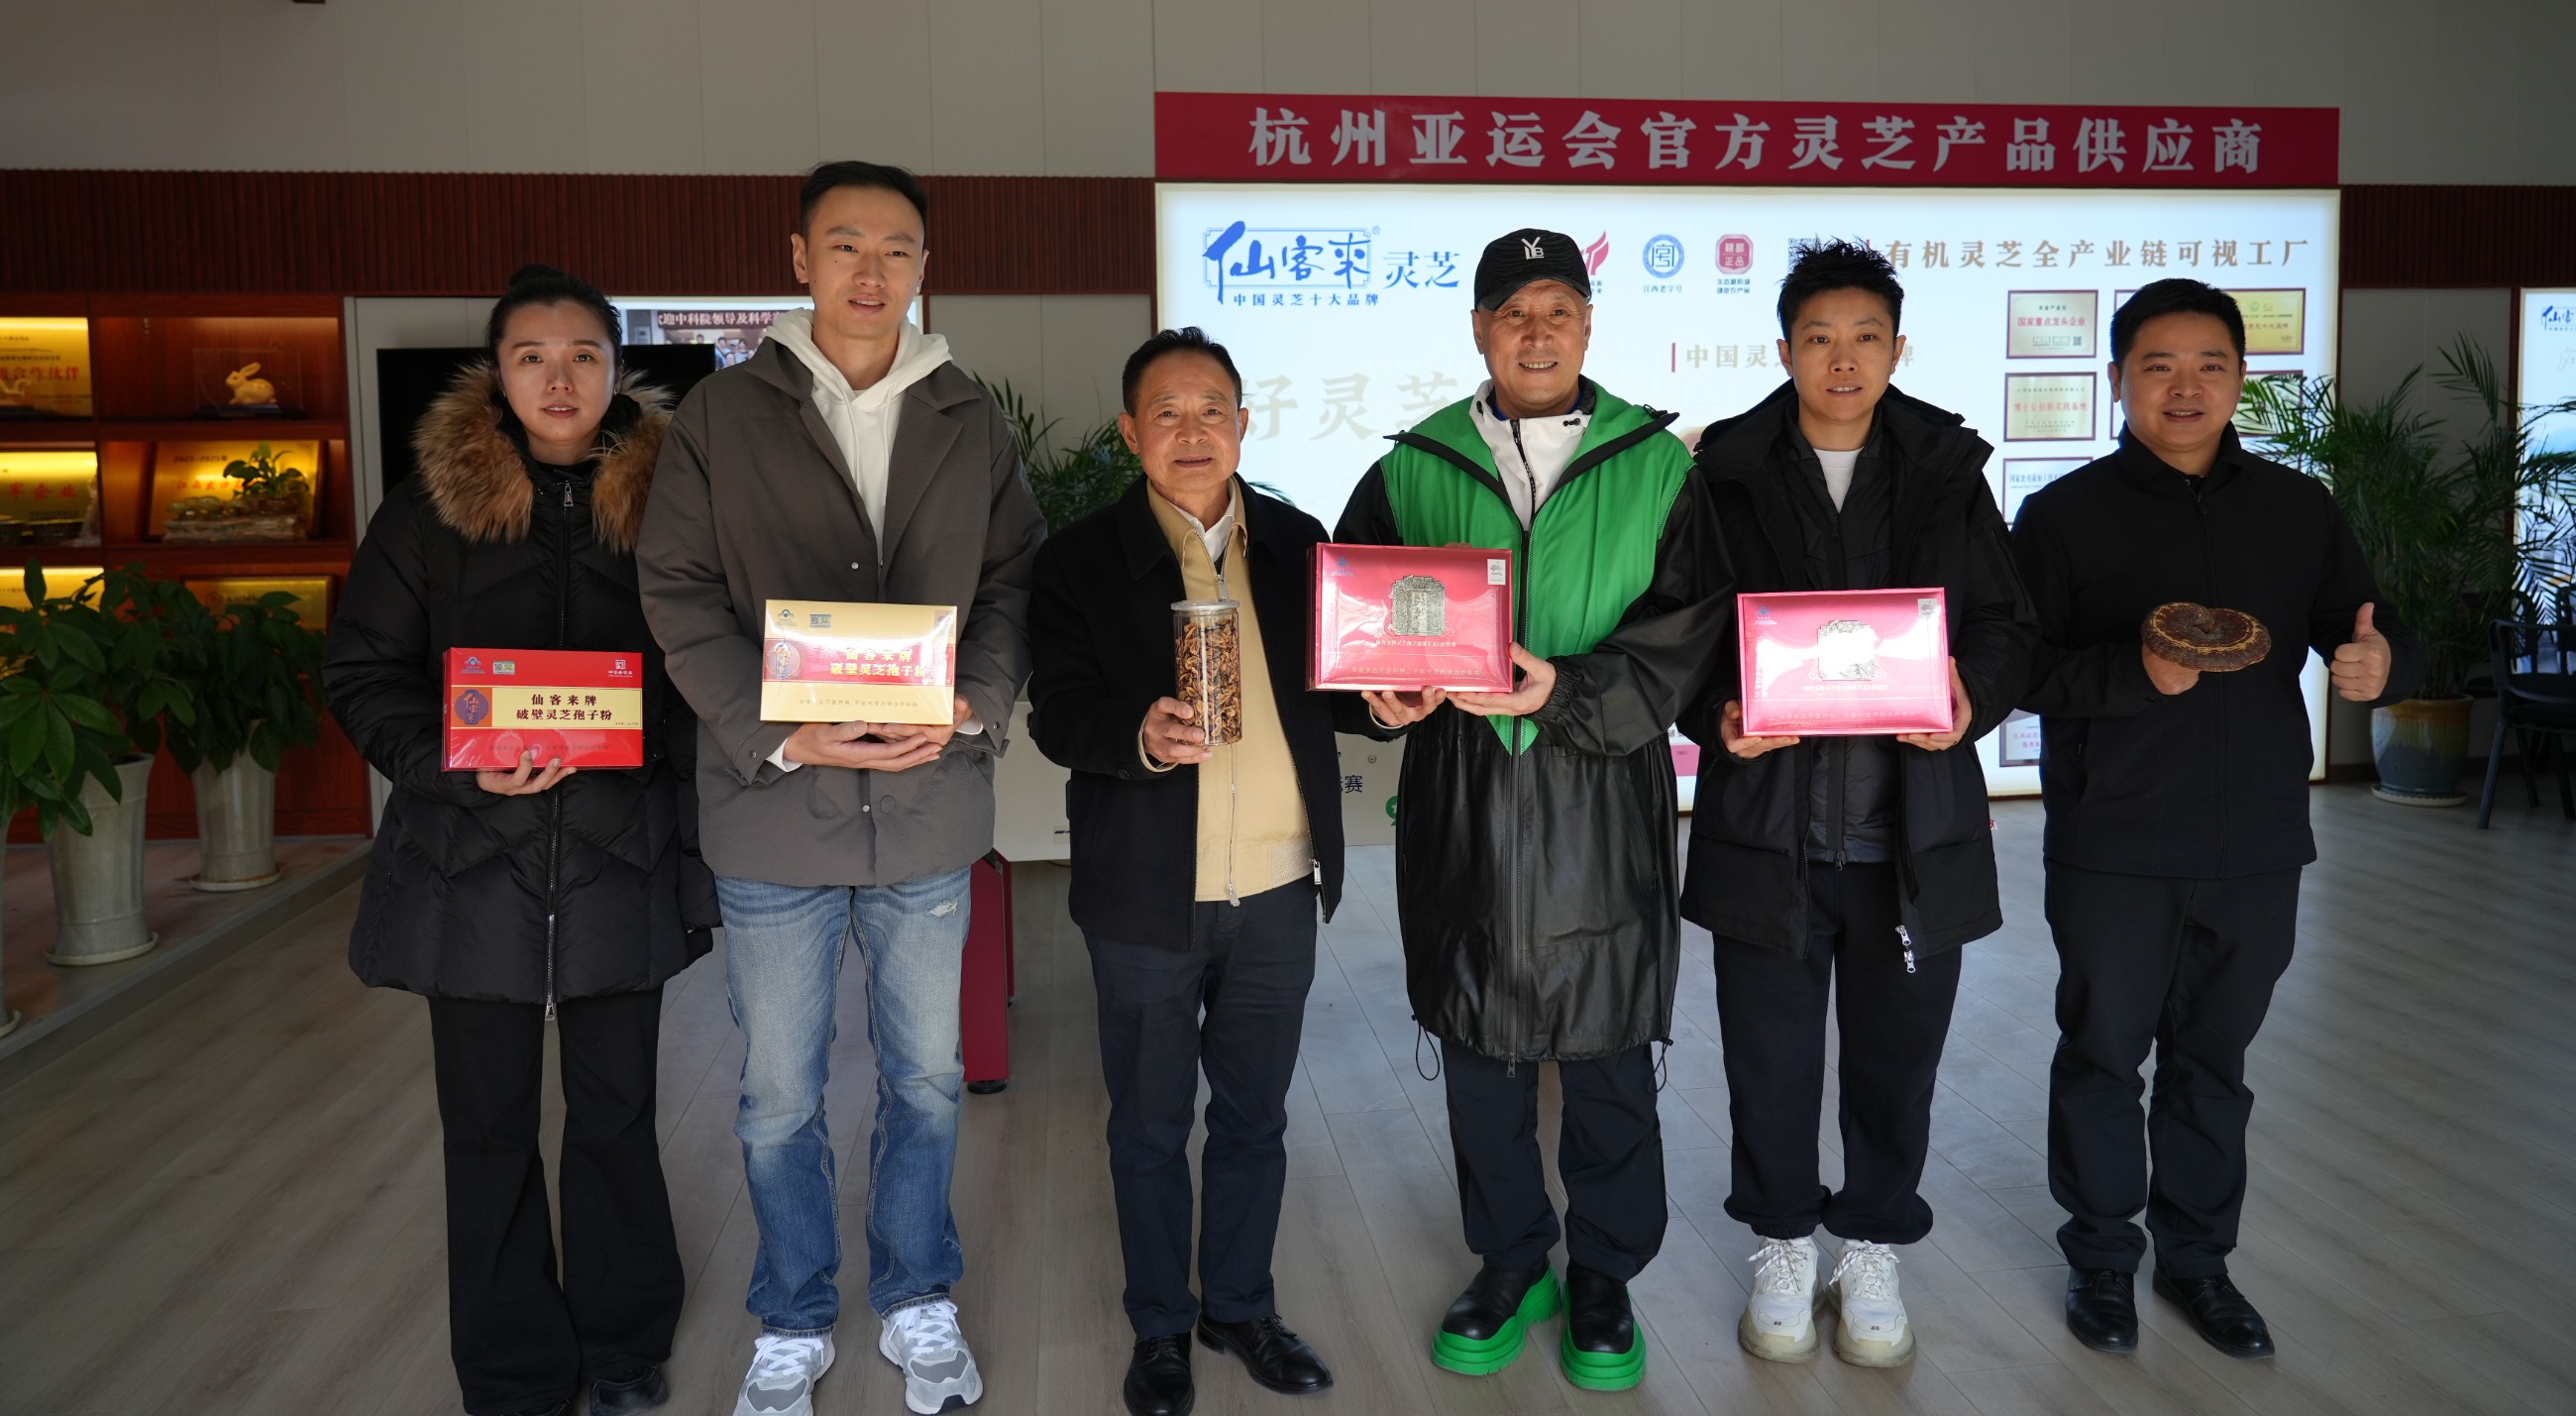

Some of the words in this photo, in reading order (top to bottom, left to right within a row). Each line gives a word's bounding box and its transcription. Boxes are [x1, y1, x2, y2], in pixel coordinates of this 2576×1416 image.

[1248, 107, 2263, 174] 杭州亚运会官方灵芝产品供应商
[1383, 251, 1460, 288] 灵芝
[1234, 293, 1379, 306] 中国灵芝十大品牌
[531, 694, 597, 707] 仙客来牌
[516, 708, 612, 721] 破壁灵芝孢子粉
